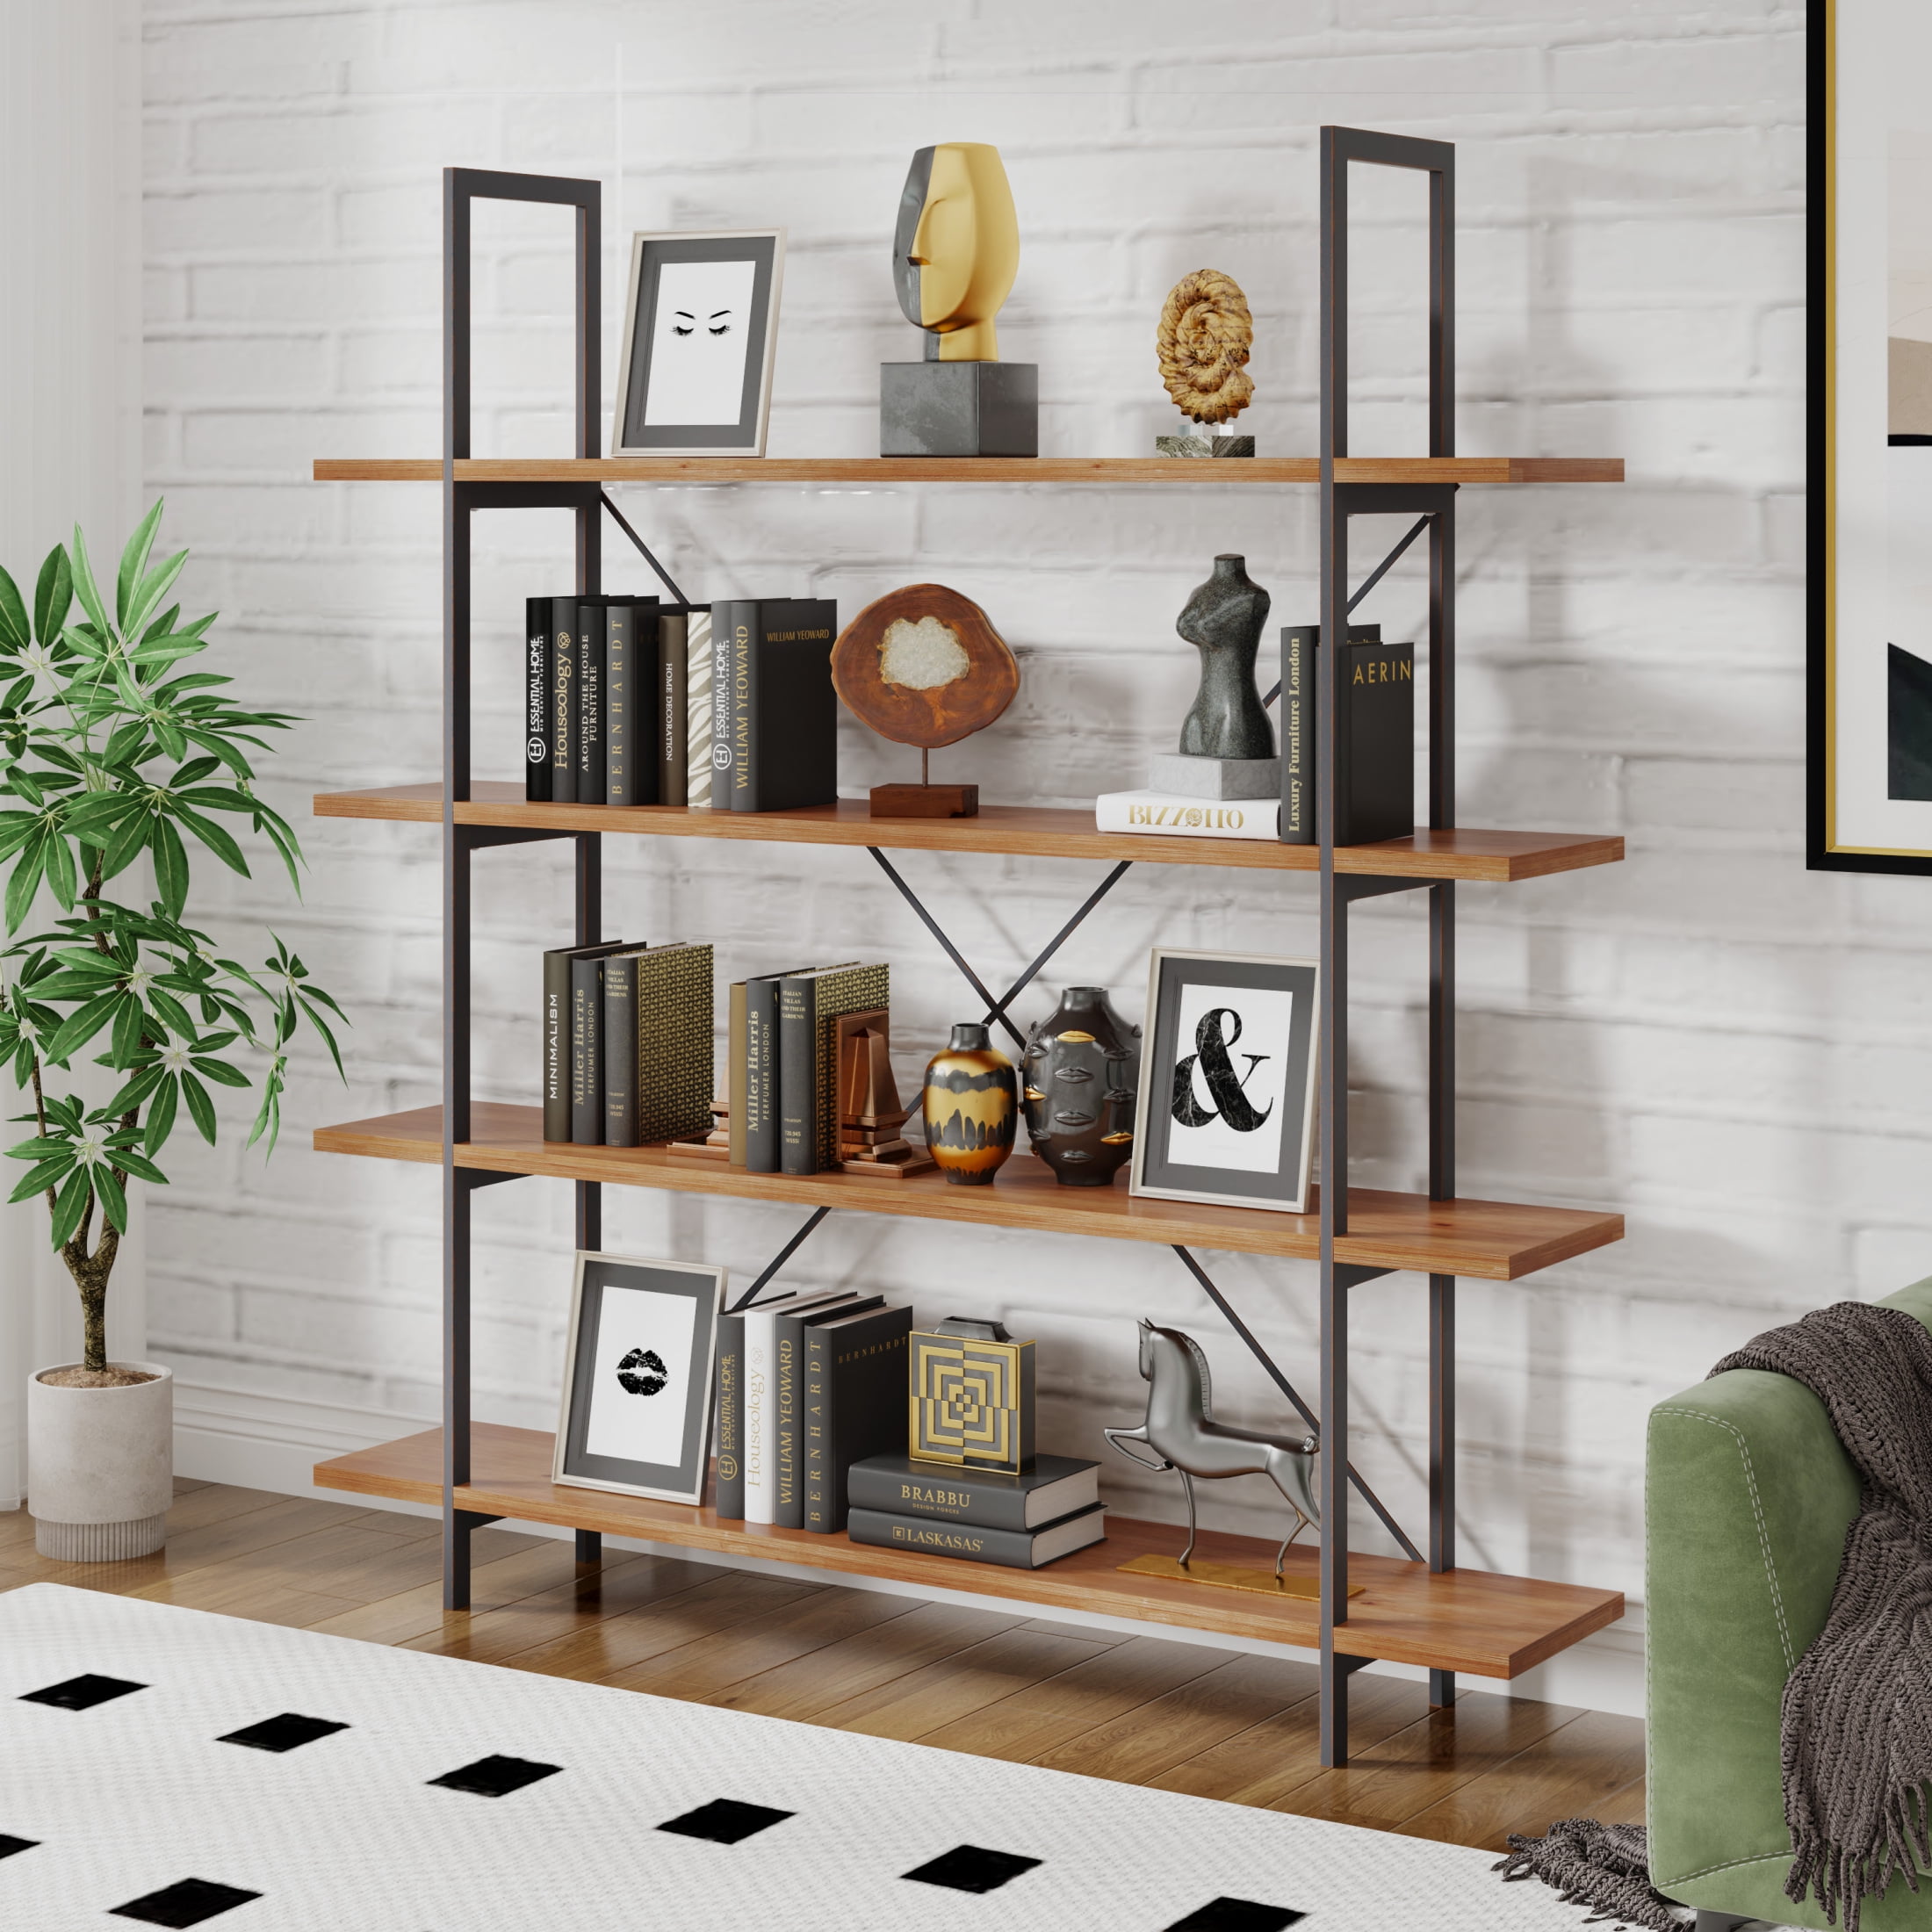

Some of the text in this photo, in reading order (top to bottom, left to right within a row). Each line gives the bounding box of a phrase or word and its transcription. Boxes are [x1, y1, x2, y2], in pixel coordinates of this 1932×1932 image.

[530, 636, 539, 732] ESSENTIAL HOME
[717, 640, 725, 739] ESSENTIAL HOME
[767, 629, 830, 643] WILLIAM YEOWARD
[1353, 660, 1411, 686] AERIN
[554, 652, 572, 770] Houseology
[611, 620, 623, 795] BERNHARDT
[736, 625, 748, 789] WILLIAM YEOWARD
[1288, 638, 1302, 832] Luxury Furniture London
[549, 994, 558, 1099] MINIMALISM
[574, 989, 584, 1106] Miller Harris
[748, 1011, 759, 1132] Miller Harris
[1171, 1007, 1273, 1132] &
[721, 1354, 732, 1450] ESSENTIAL HOME
[747, 1368, 764, 1488] Houseology
[780, 1339, 792, 1504] WILLIAM YEOWARD
[810, 1341, 821, 1522] BERNHARDT
[901, 1484, 970, 1508] BRABBU
